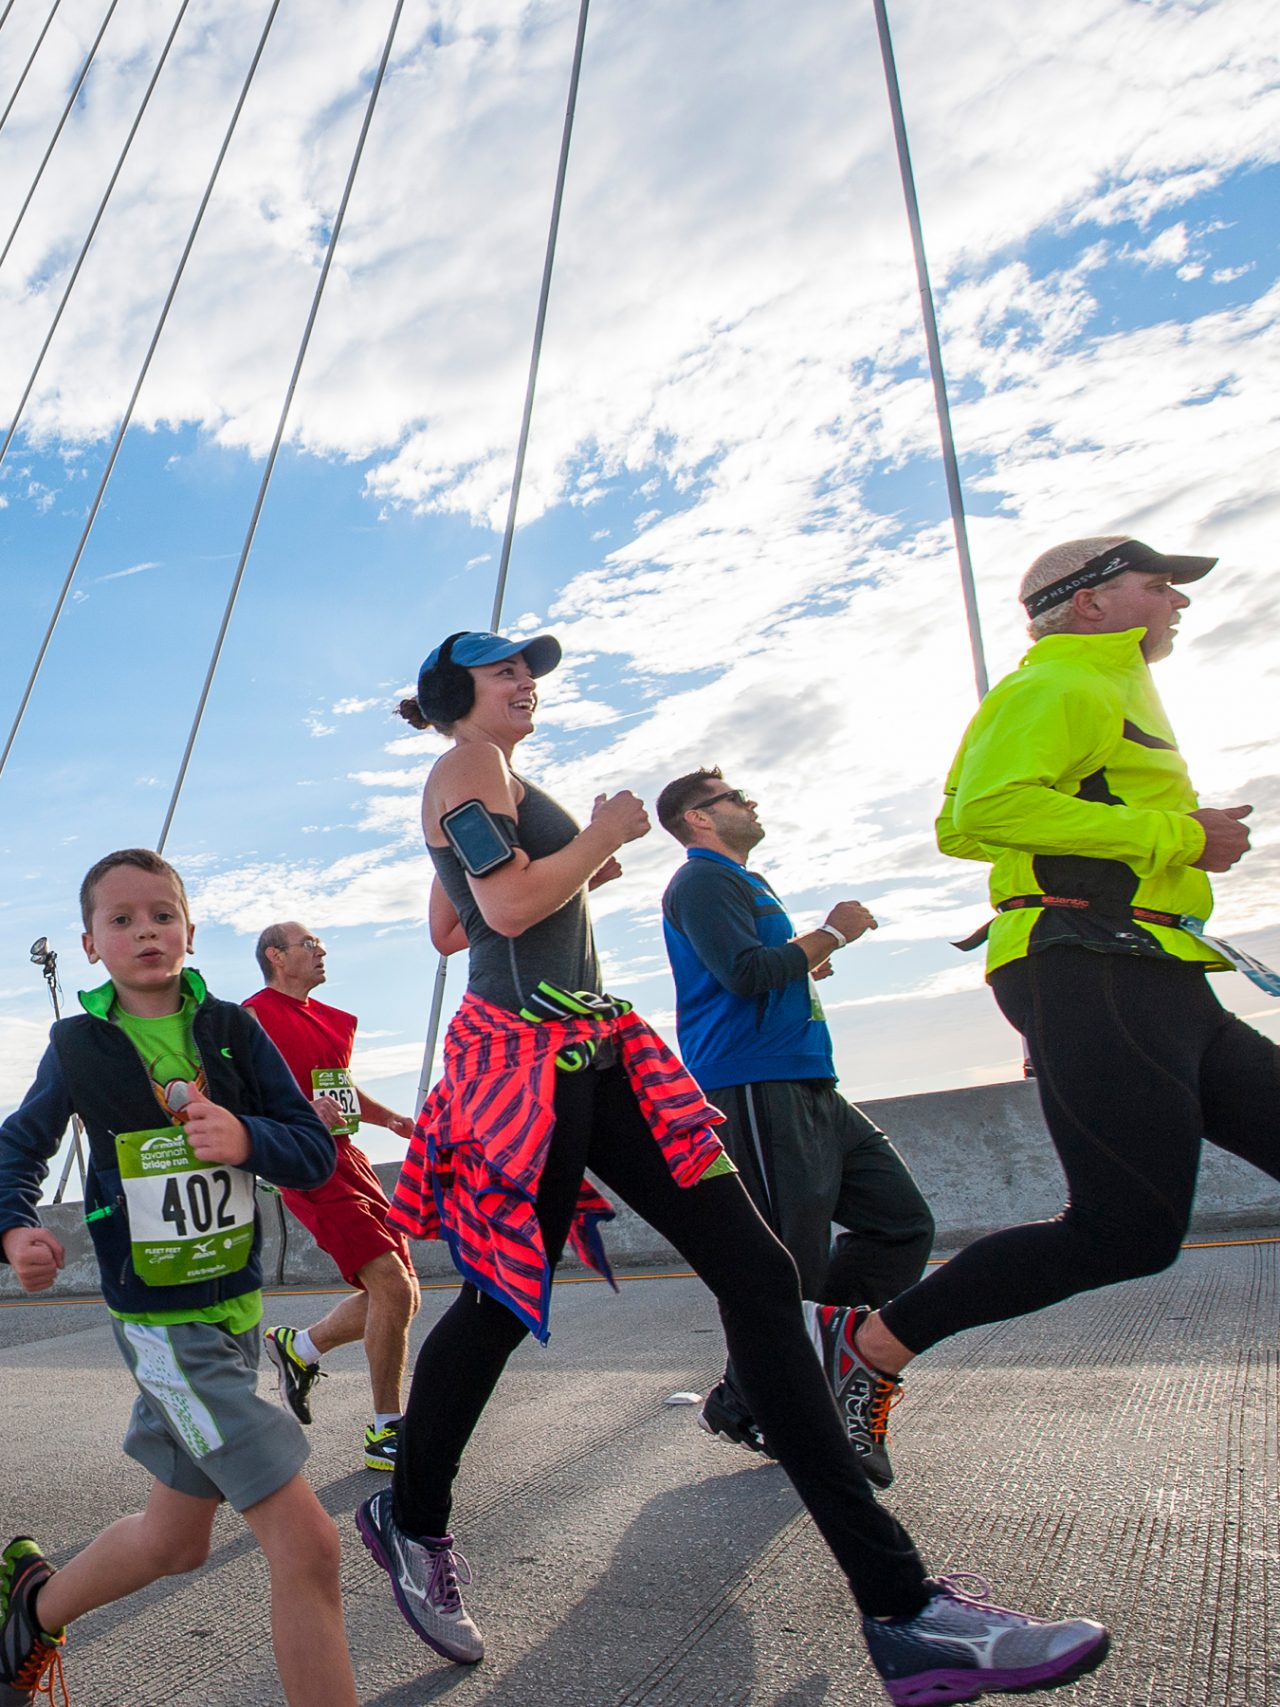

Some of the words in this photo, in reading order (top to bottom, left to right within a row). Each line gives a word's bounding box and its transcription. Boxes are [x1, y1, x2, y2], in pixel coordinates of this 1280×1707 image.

[320, 1089, 356, 1113] 62
[140, 1147, 187, 1160] savannah
[142, 1160, 171, 1169] bridge
[173, 1158, 188, 1166] run
[162, 1170, 235, 1236] 402
